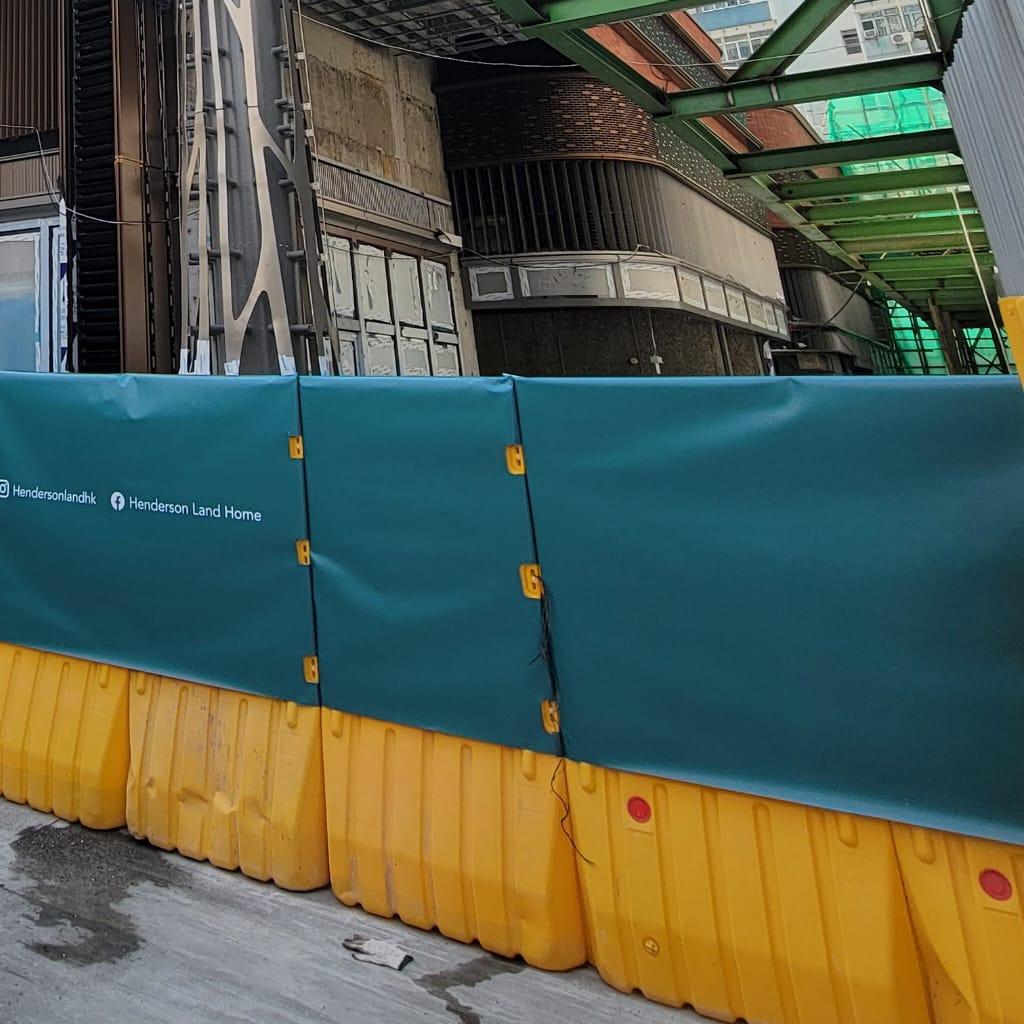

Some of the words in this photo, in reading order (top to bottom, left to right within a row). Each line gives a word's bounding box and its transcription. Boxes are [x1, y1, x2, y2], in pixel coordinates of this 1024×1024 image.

[12, 484, 97, 505] Hendersonlandhk
[129, 496, 189, 516] Henderson
[192, 502, 221, 518] Land
[224, 506, 262, 522] Home
